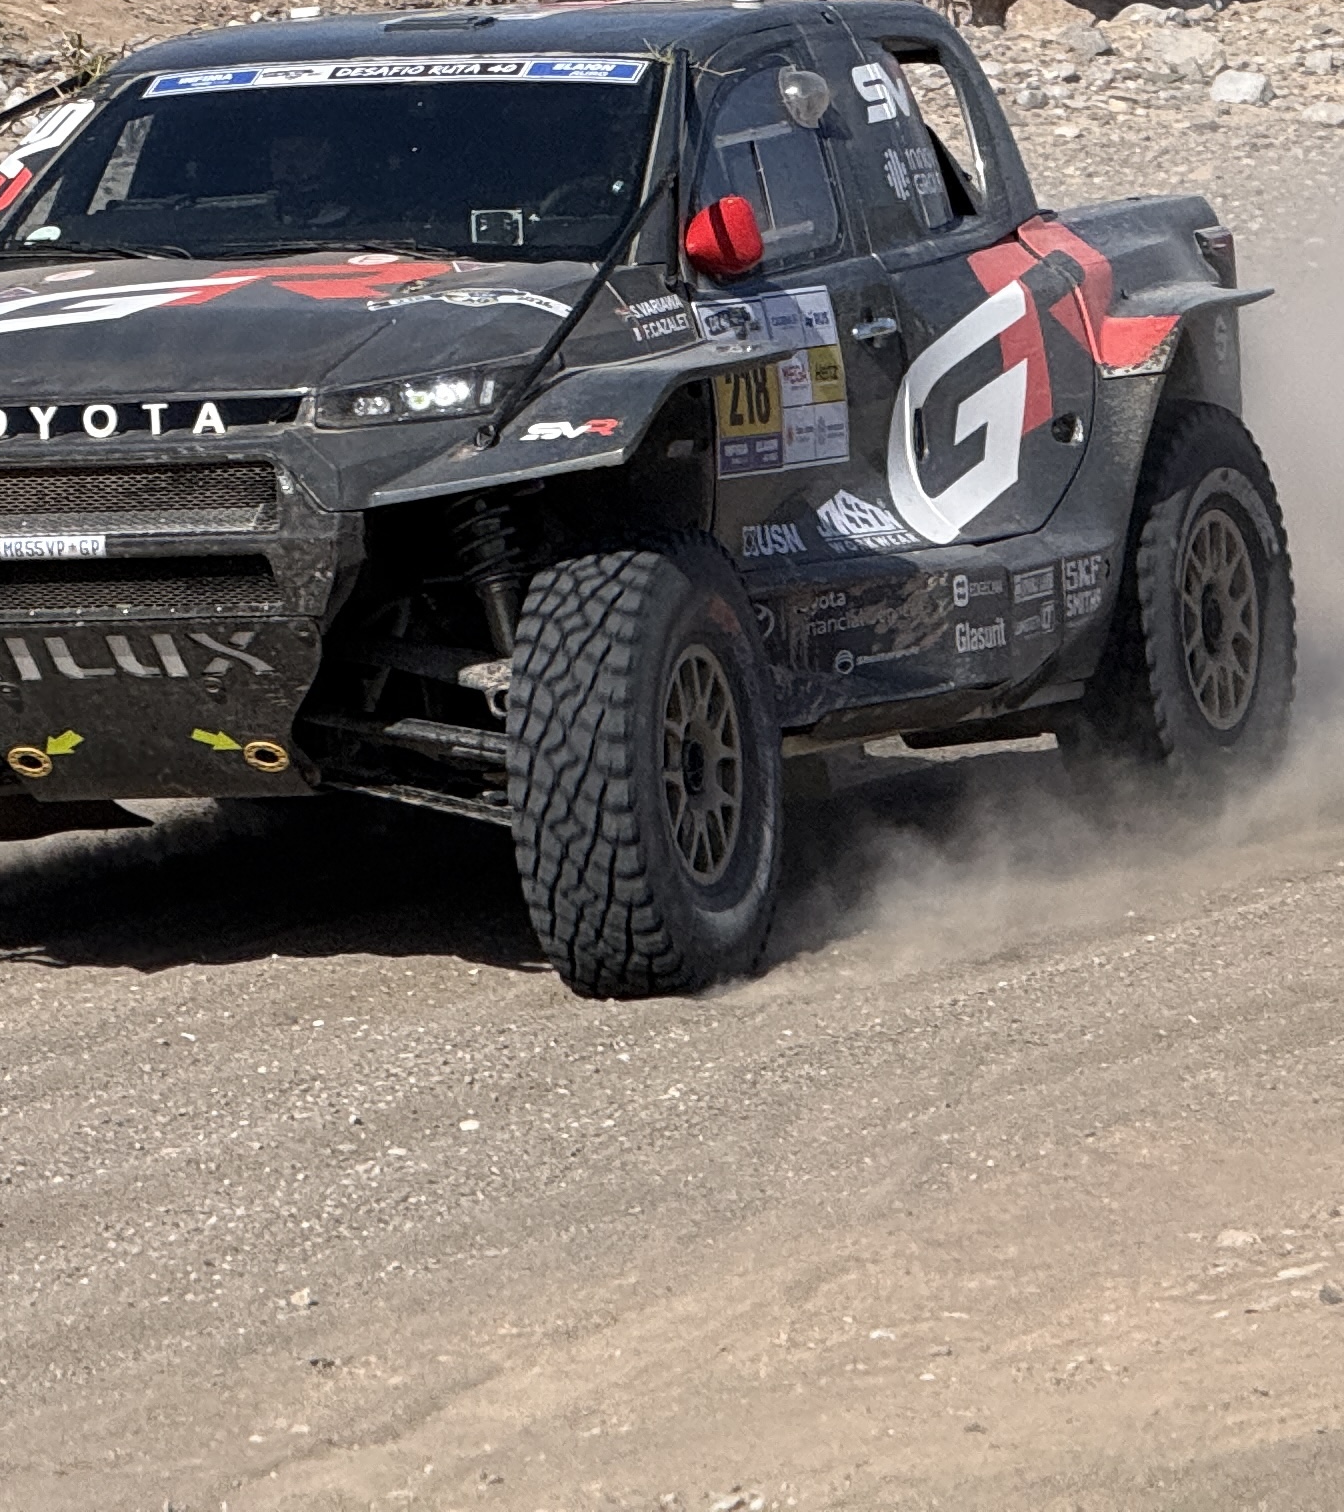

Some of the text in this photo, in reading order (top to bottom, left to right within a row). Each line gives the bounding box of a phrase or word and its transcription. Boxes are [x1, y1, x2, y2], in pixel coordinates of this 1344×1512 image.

[336, 64, 422, 78] DESAFIO
[428, 63, 480, 76] RUTA
[488, 63, 518, 74] 40
[519, 418, 619, 441] SVR
[757, 523, 807, 555] USN
[1066, 555, 1102, 590] SKF
